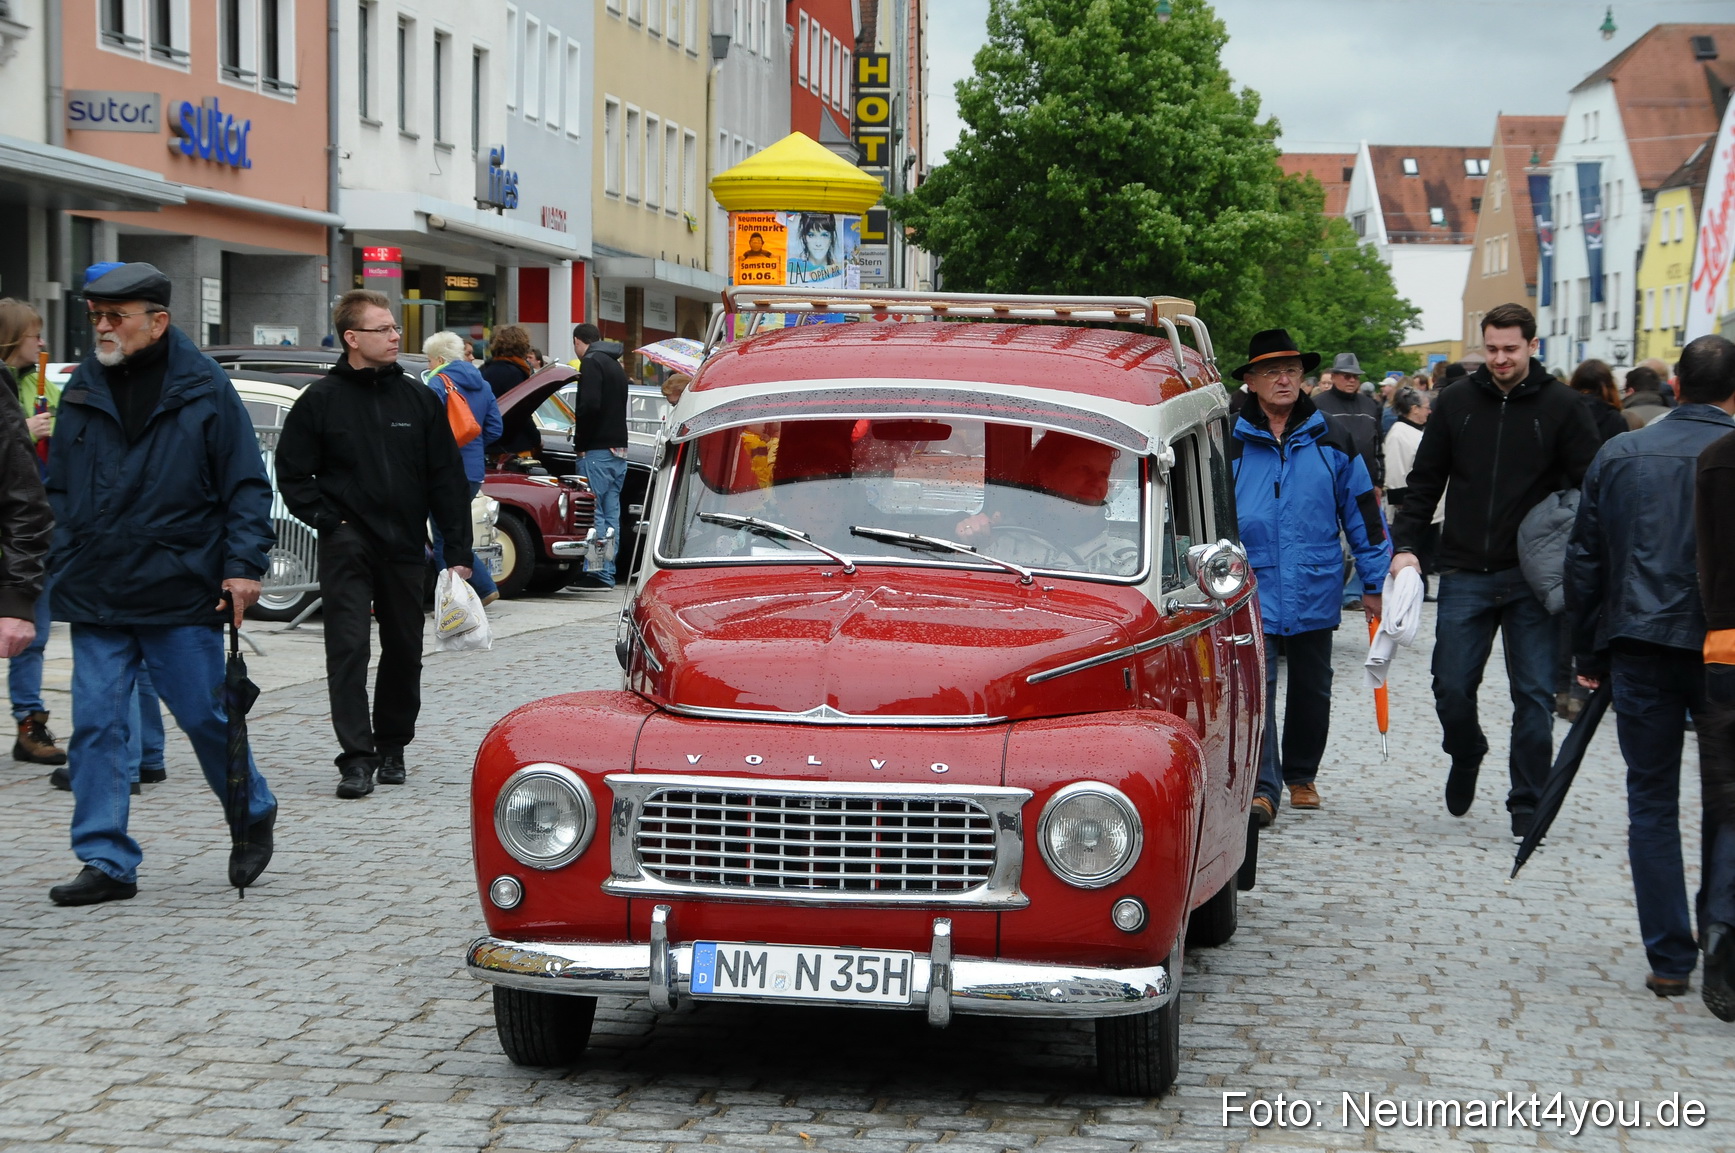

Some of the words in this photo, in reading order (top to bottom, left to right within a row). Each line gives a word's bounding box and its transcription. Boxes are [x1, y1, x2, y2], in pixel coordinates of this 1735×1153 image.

[68, 97, 153, 124] sutor.
[174, 96, 251, 169] sutor.
[857, 57, 888, 240] HOTL
[487, 144, 519, 209] fries
[737, 215, 776, 223] Neumarkt
[738, 223, 785, 233] Flohmarkt
[741, 262, 777, 270] Samstag
[859, 257, 882, 266] Stern
[741, 272, 775, 281] 01.06.
[789, 260, 808, 285] ZAZ
[810, 269, 830, 282] OPEN
[831, 265, 841, 277] AIR
[686, 754, 949, 774] VOLVO
[699, 973, 707, 984] D
[714, 949, 768, 989] NM
[795, 953, 822, 991] N
[830, 954, 909, 996] 35H
